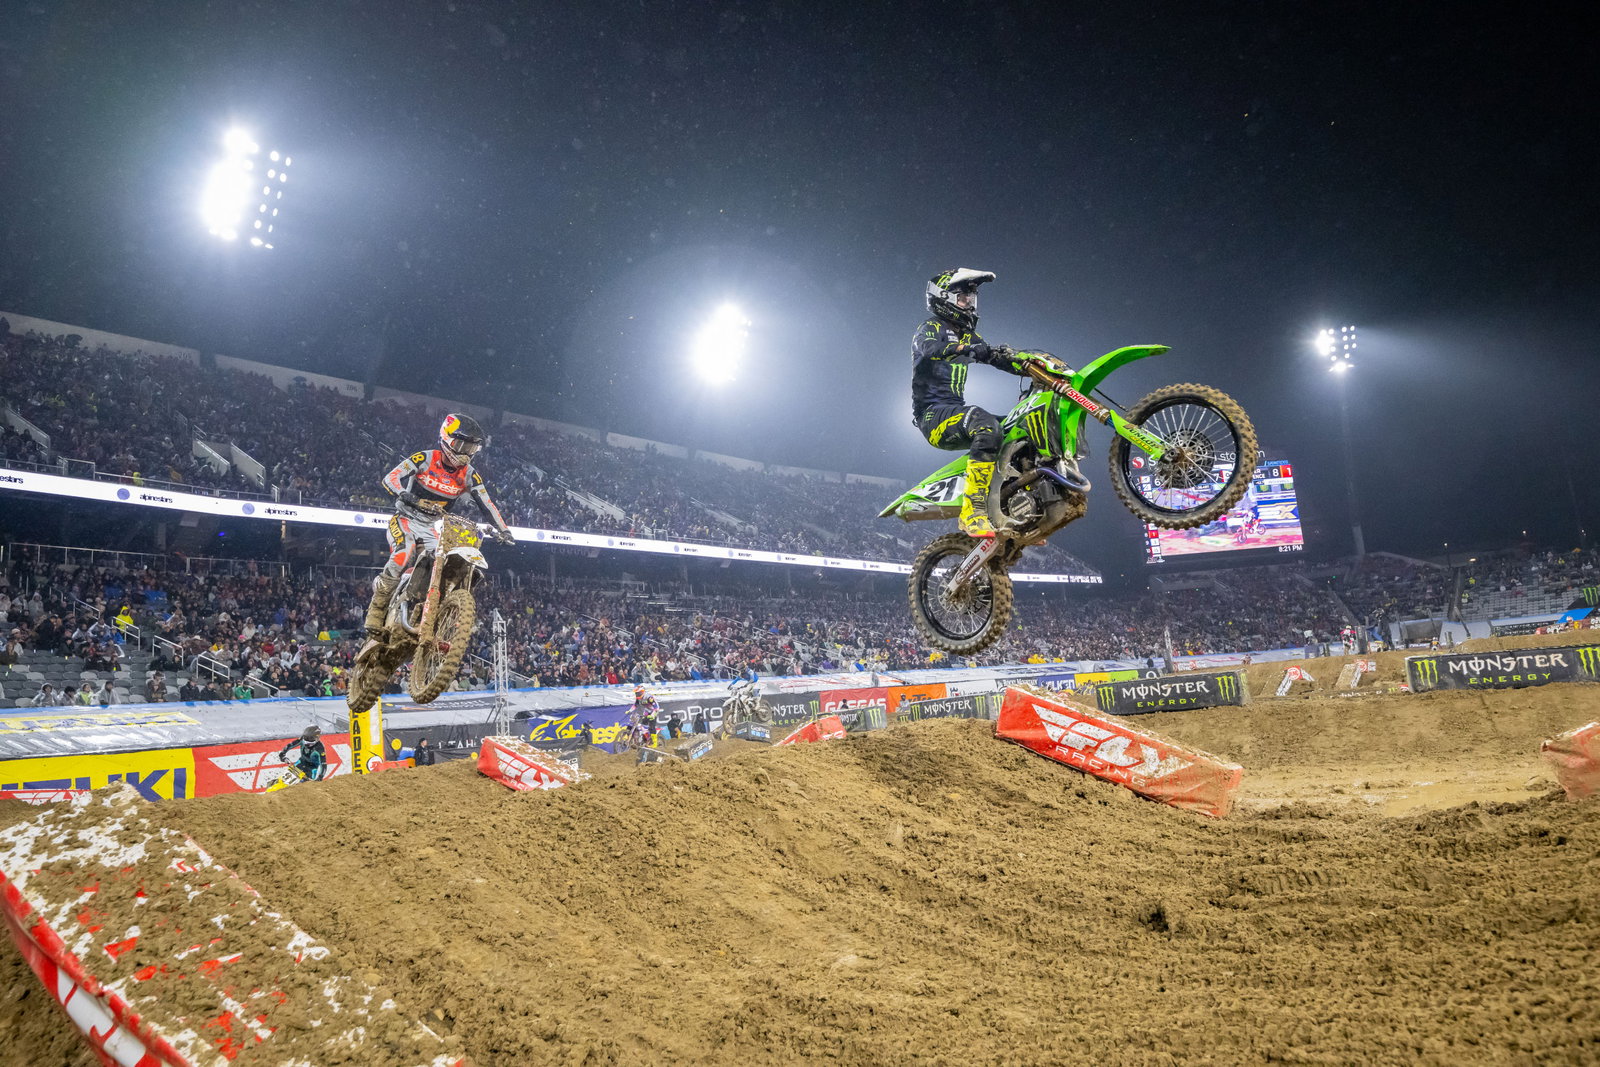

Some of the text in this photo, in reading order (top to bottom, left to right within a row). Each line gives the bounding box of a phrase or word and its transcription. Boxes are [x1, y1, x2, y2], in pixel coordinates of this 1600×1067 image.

[1067, 389, 1099, 412] SHOWA
[924, 476, 958, 502] 21
[1448, 653, 1569, 675] MONSTER
[1469, 673, 1551, 685] ENERGY
[1122, 680, 1210, 699] MONSTER
[772, 704, 807, 717] NSTER
[924, 700, 972, 715] MONSTER
[1137, 697, 1197, 708] ENERGY
[656, 705, 724, 724] GoPro
[1056, 745, 1148, 787] RACING
